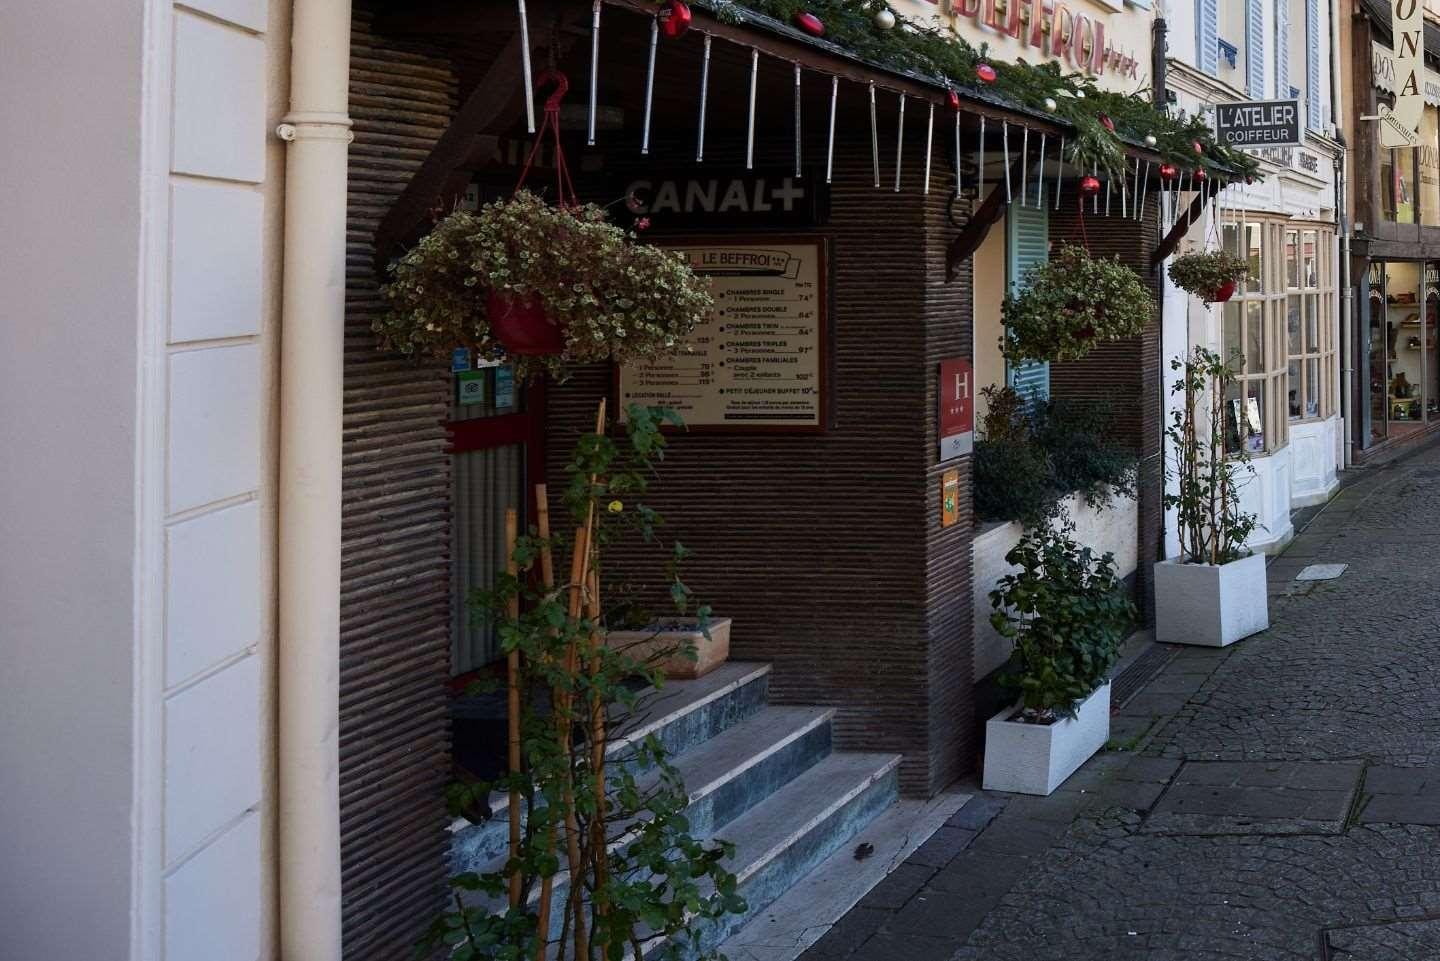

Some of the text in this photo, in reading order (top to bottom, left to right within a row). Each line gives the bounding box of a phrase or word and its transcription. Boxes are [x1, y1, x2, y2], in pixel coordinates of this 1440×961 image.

[1374, 52, 1396, 81] DON
[1219, 105, 1295, 128] L'ATELIER
[1226, 129, 1289, 142] COIFFEUR
[625, 176, 805, 214] CANAL+
[703, 253, 716, 265] LE
[720, 253, 770, 266] BEFFROI
[953, 372, 969, 401] H
